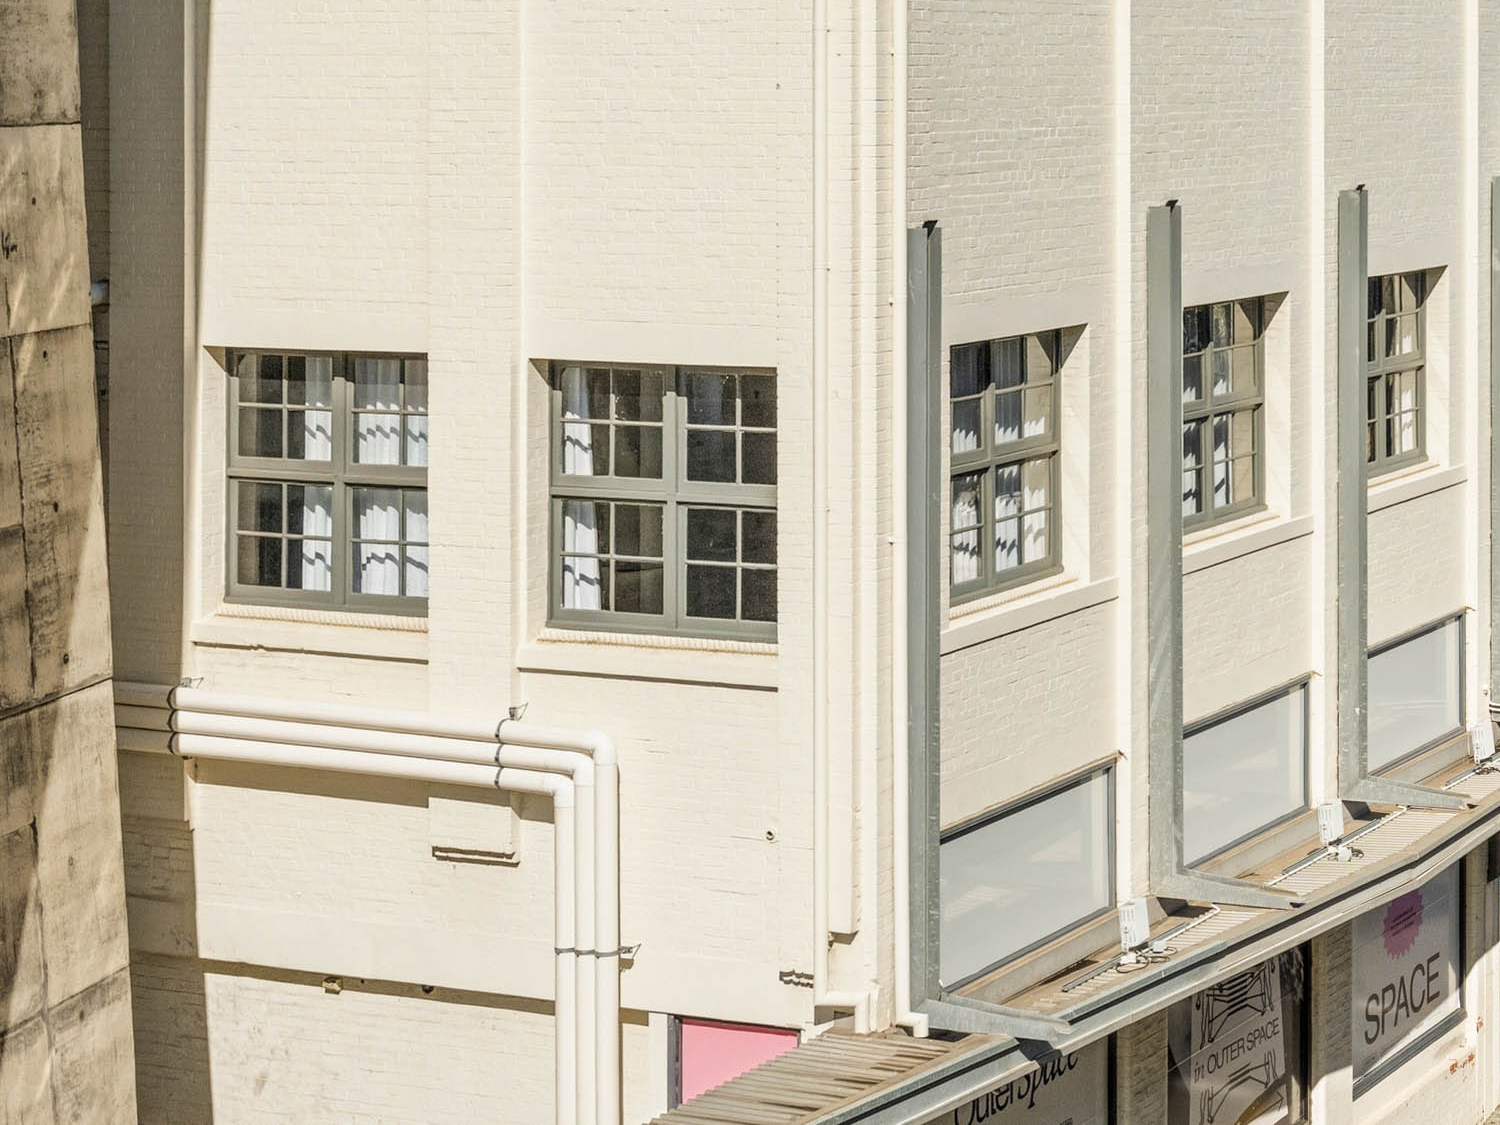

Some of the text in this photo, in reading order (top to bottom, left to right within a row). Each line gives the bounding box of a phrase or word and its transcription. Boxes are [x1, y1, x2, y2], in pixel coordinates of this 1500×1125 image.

[1364, 951, 1441, 1045] SPACE
[1207, 1037, 1246, 1075] OUTER
[1246, 1017, 1281, 1052] SPACE
